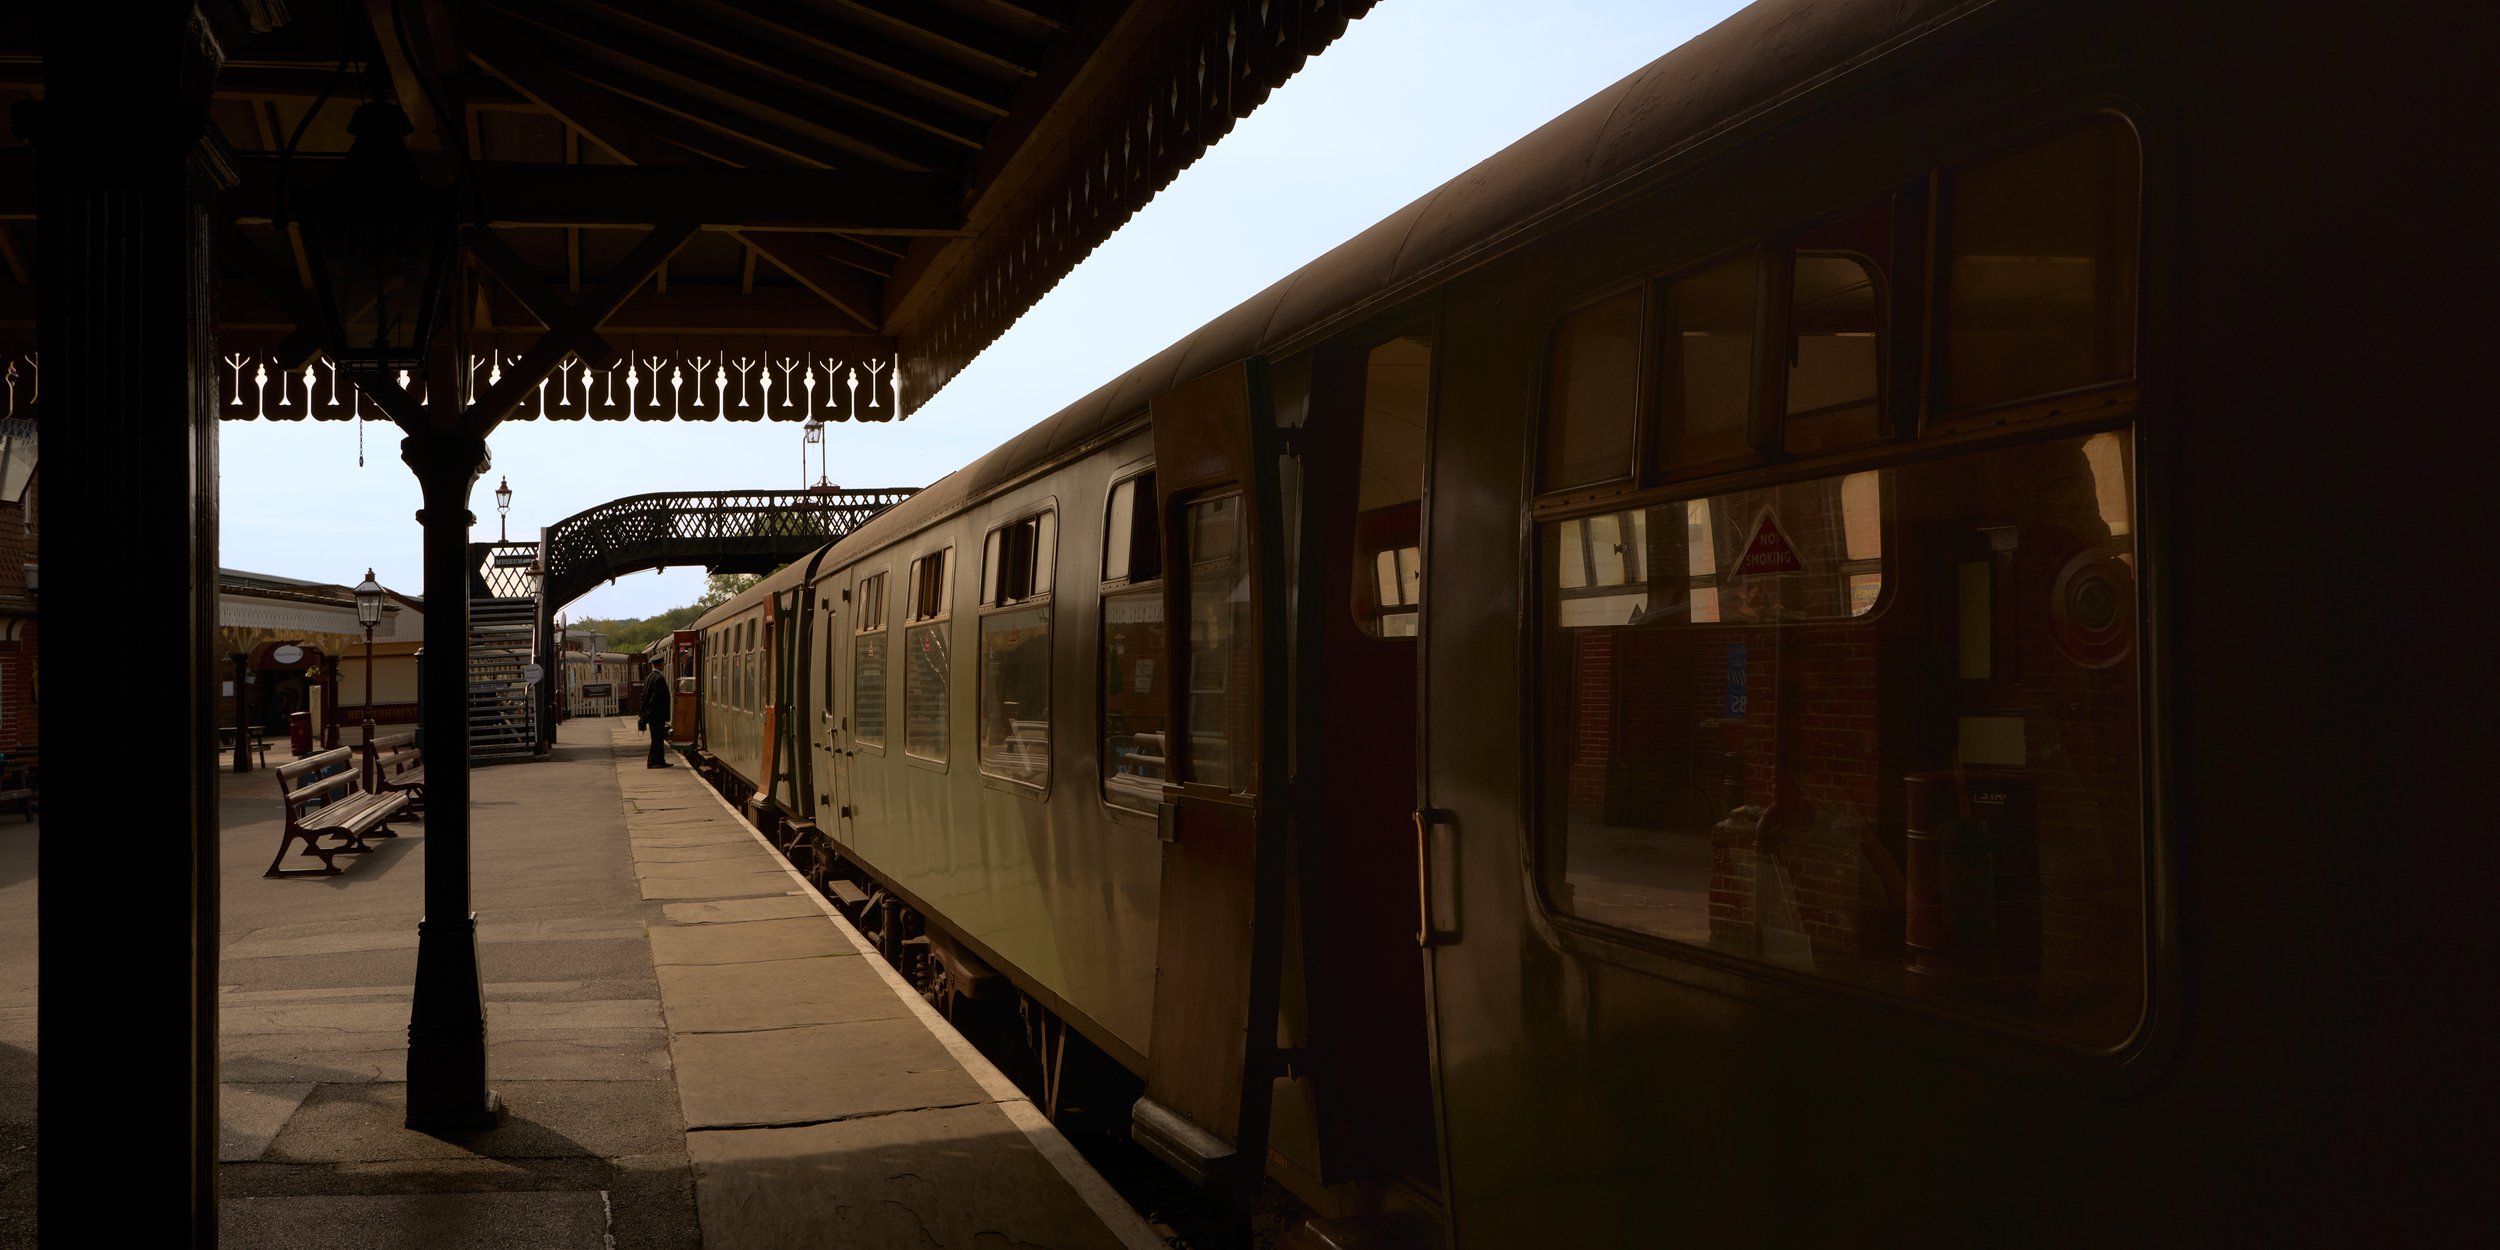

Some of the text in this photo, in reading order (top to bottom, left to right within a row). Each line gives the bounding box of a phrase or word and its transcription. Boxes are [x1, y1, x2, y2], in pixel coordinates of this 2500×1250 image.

[0, 419, 39, 431] EFFIE
[2, 427, 33, 439] PARK
[1761, 533, 1776, 545] NO
[1746, 550, 1792, 567] SMOKING
[348, 706, 418, 720] REFESHMENT
